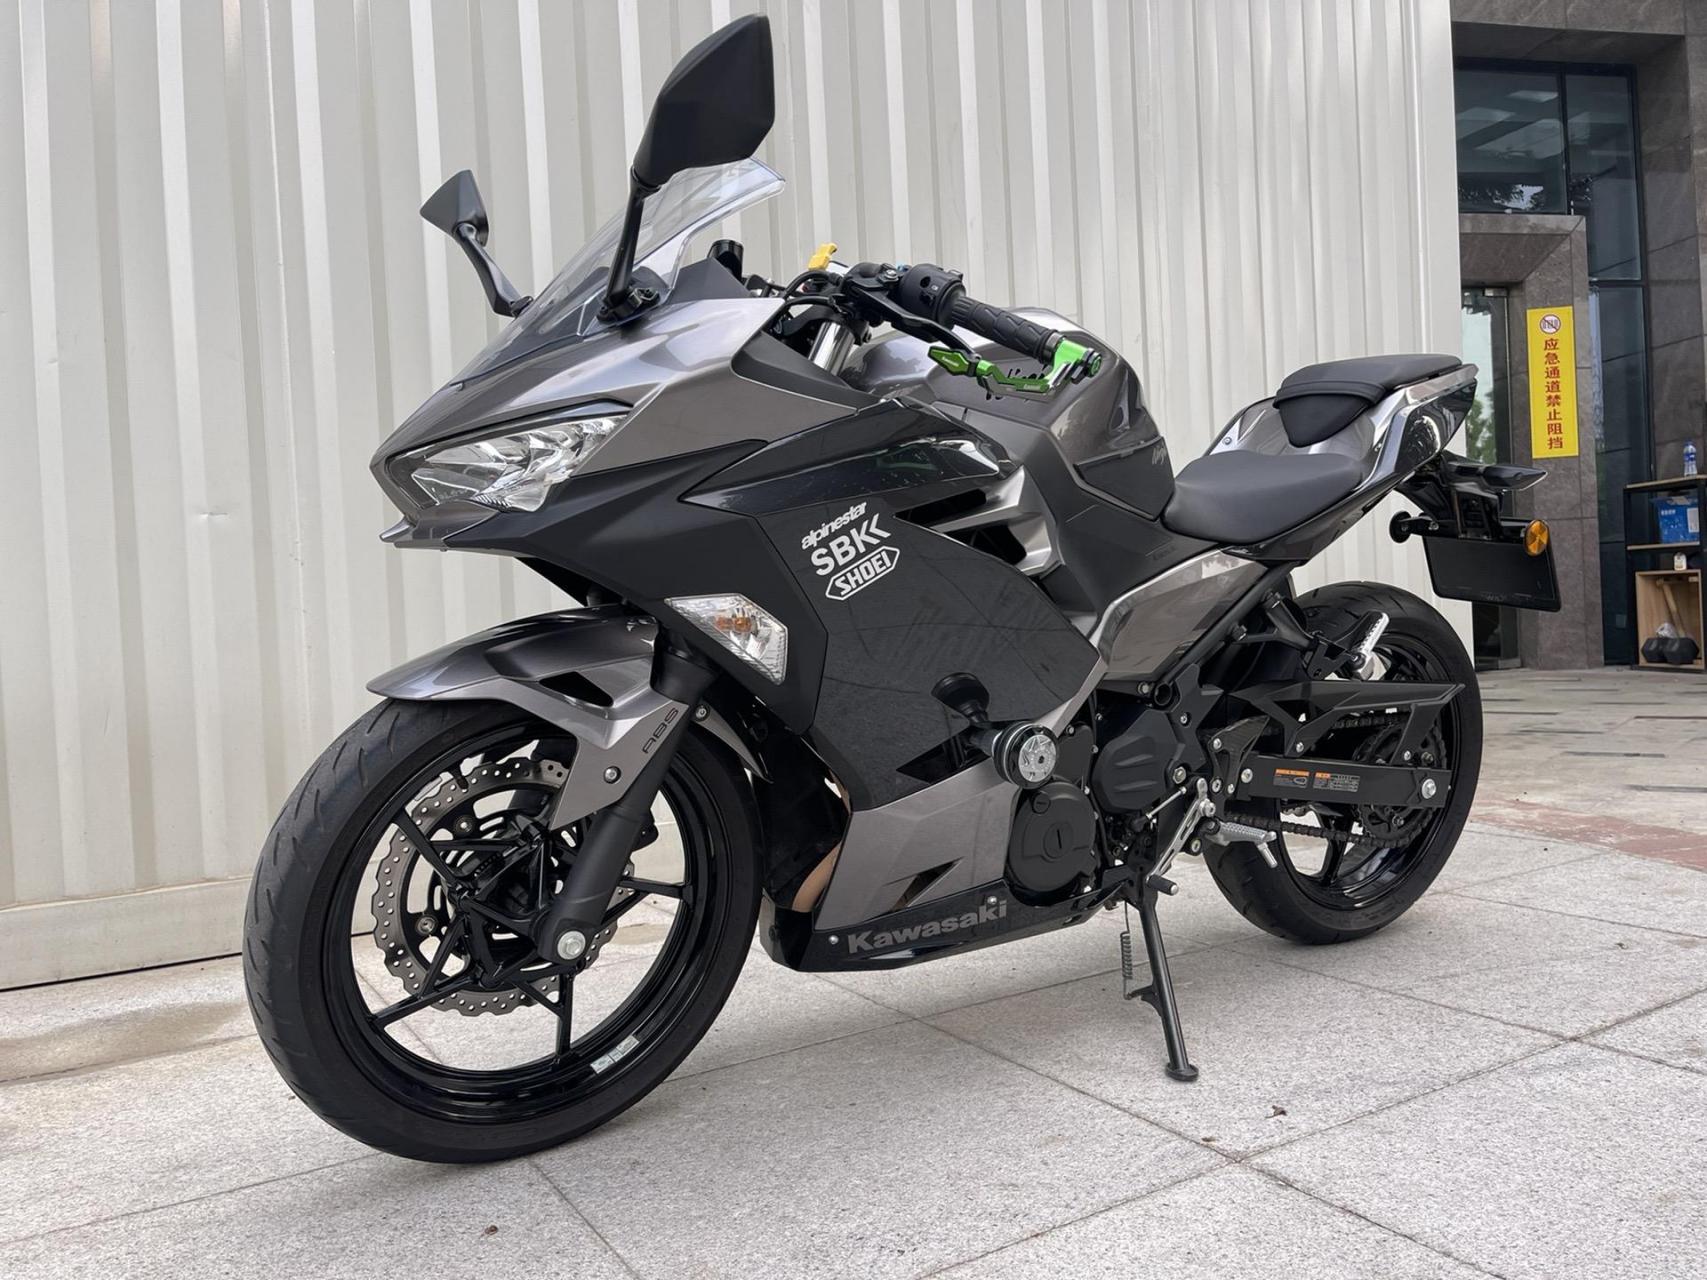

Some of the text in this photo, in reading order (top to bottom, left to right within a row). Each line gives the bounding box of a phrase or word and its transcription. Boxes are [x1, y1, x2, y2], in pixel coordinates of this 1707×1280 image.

[1544, 338, 1563, 450] 应急通道禁止阻挡
[801, 502, 867, 550] alpinestar
[811, 513, 891, 576] SBK
[834, 551, 892, 596] SHOEI
[642, 707, 679, 754] ABS
[847, 900, 1007, 953] Kawasaki
